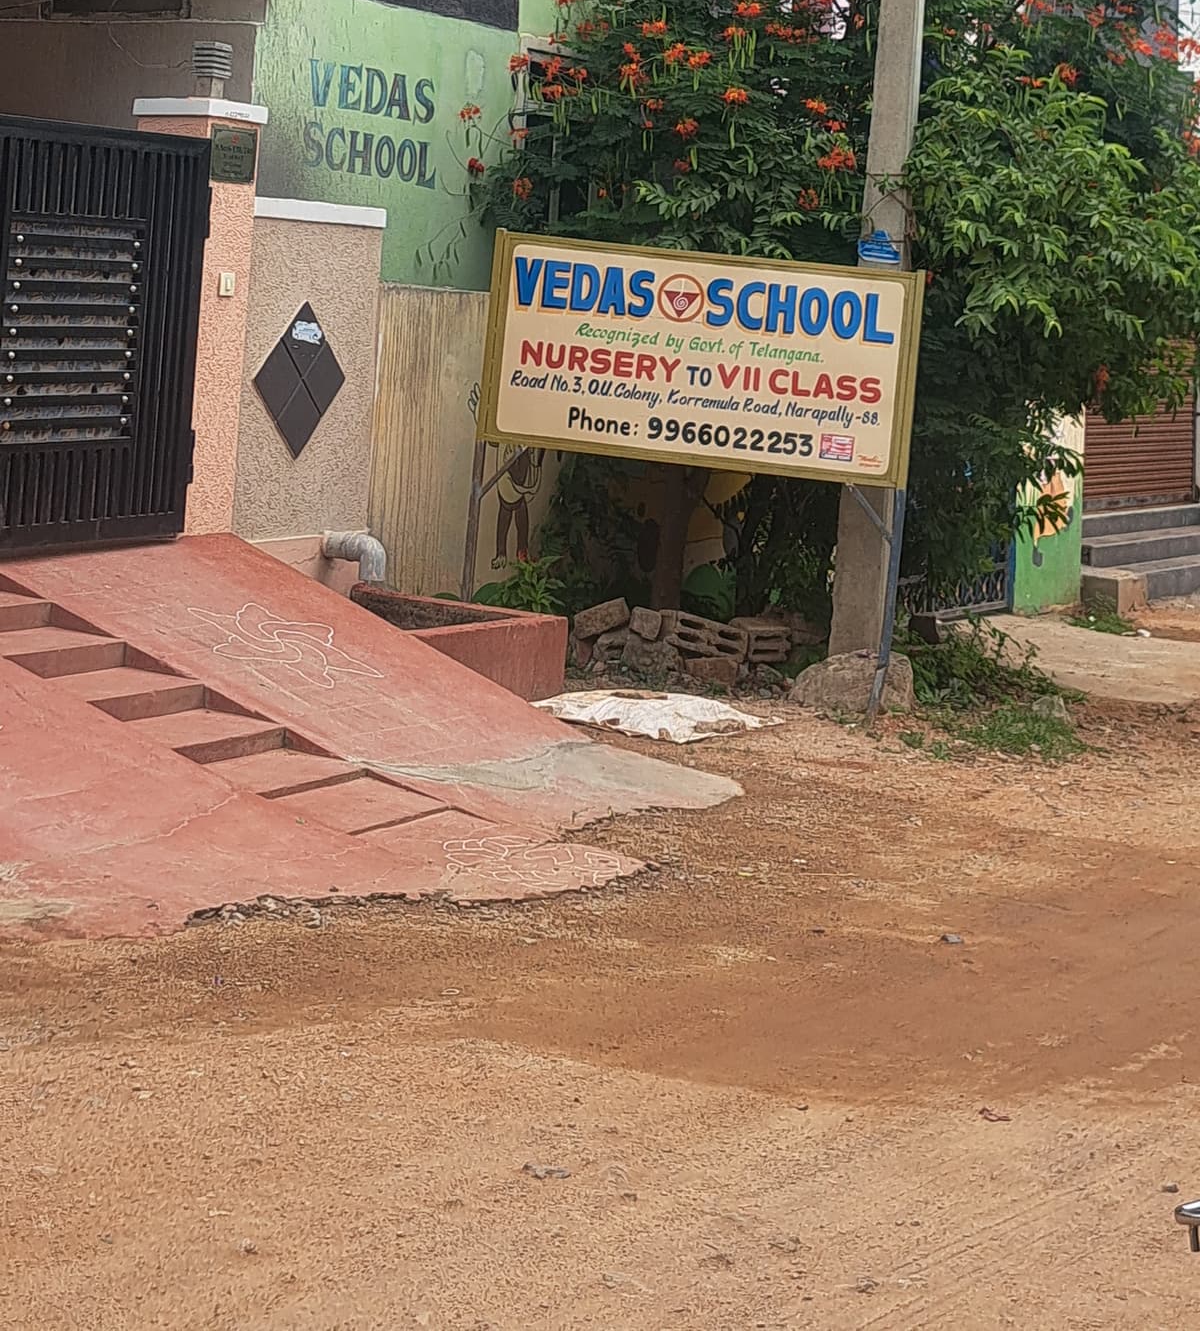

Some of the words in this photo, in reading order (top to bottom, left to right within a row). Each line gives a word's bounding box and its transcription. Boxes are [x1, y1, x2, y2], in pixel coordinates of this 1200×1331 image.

[309, 59, 435, 125] VEDAS
[303, 121, 436, 190] SCHOOL
[514, 256, 656, 320] VEDAS
[705, 278, 894, 347] SCHOOL
[520, 339, 682, 384] NURSERY
[686, 365, 712, 387] TO
[717, 363, 761, 392] VII
[768, 369, 882, 404] CLASS
[575, 322, 660, 348] Recognized
[665, 333, 684, 354] by
[688, 336, 725, 354] Govt.
[728, 340, 744, 361] of
[749, 341, 824, 365] Telangana.
[510, 370, 549, 390] Road
[666, 388, 740, 411] Korremula
[742, 397, 782, 417] Road,
[567, 406, 639, 436] Phone:
[647, 416, 814, 457] 9966022253
